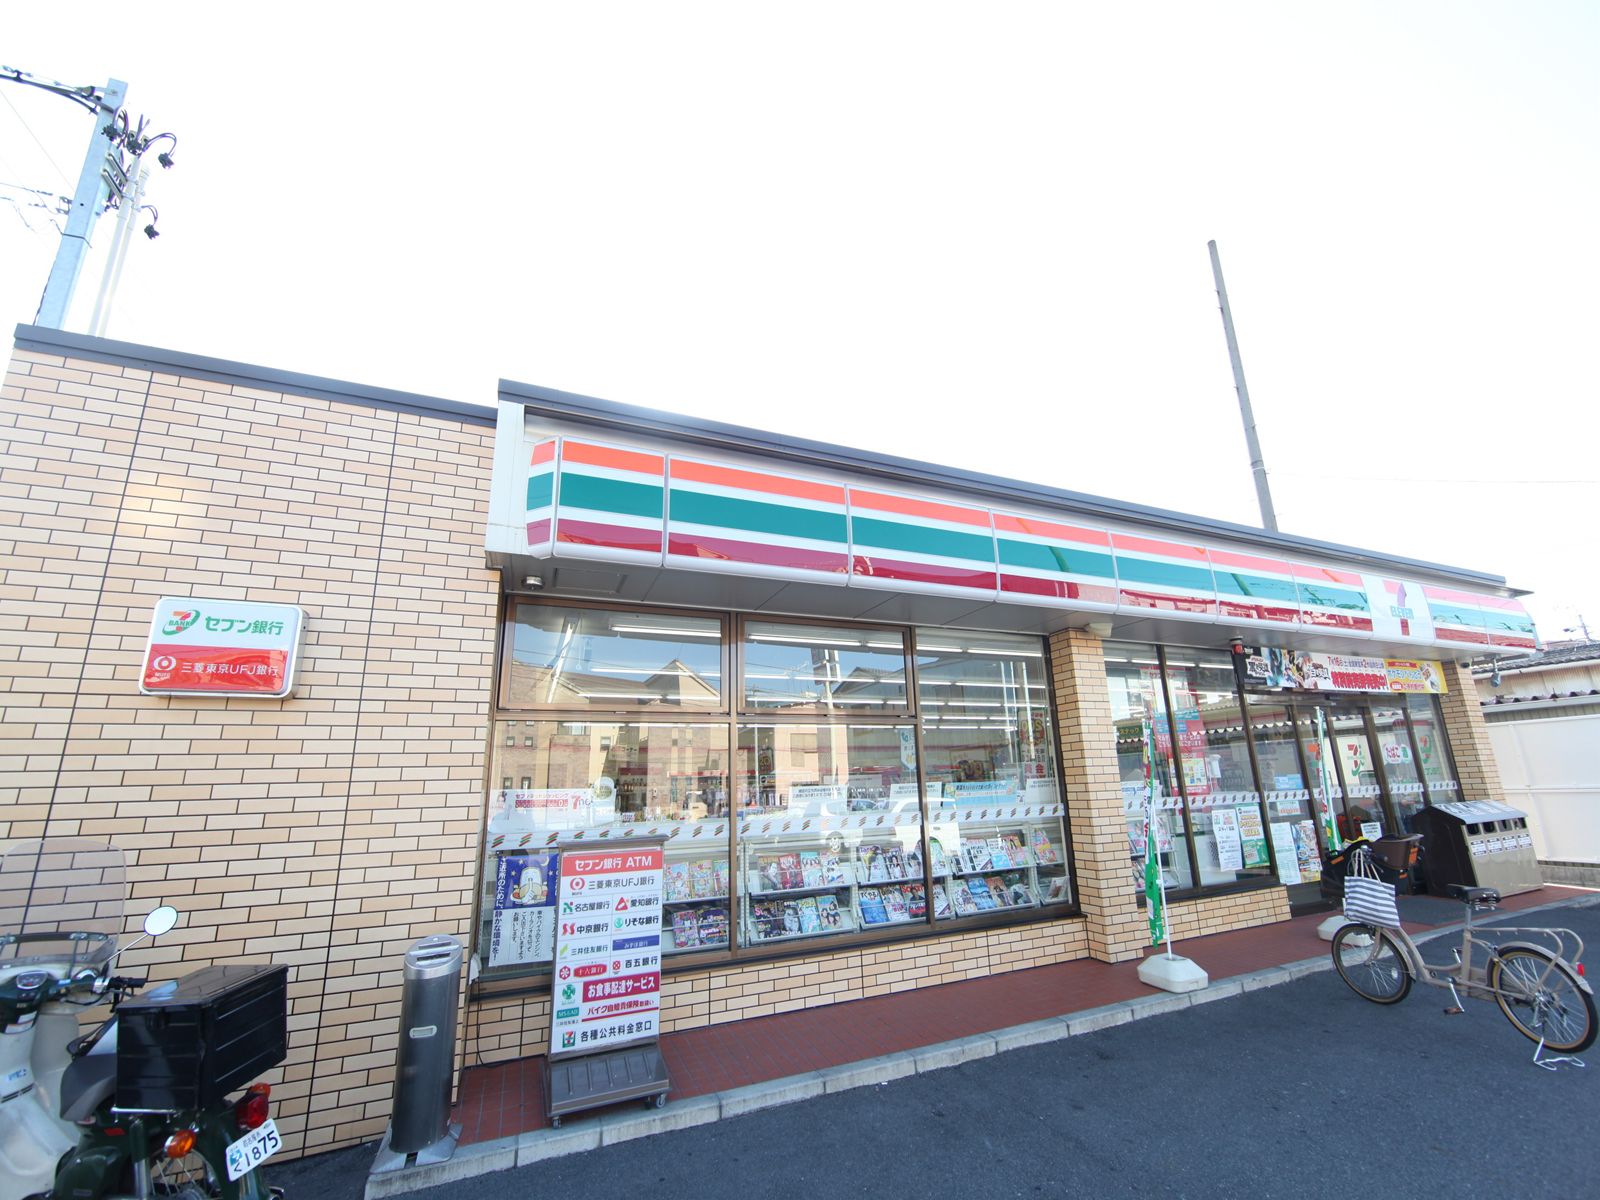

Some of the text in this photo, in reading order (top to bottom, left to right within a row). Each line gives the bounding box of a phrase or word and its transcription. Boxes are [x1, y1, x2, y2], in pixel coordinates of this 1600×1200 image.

[1391, 606, 1414, 619] ELEVEN
[168, 619, 191, 627] BANK
[205, 616, 284, 636] セブン銀行
[181, 661, 280, 678] 三菱東京UFJ銀行
[575, 855, 652, 872] セブン銀行 ATM
[588, 876, 655, 890] 三菱東京UFJ銀行
[574, 901, 610, 912] 名古屋銀行
[630, 897, 659, 908] 愛知銀行
[625, 915, 659, 927] りそな銀行
[576, 923, 609, 934] 中京銀行
[571, 945, 608, 956] 三井住友銀行
[624, 941, 648, 949] みずほ銀行
[624, 956, 658, 969] 百五銀行
[578, 966, 603, 975] 十六銀行
[587, 976, 655, 998] お食事配達サービス
[580, 1020, 652, 1042] 各種公共料金窓口
[245, 1130, 279, 1167] 1875
